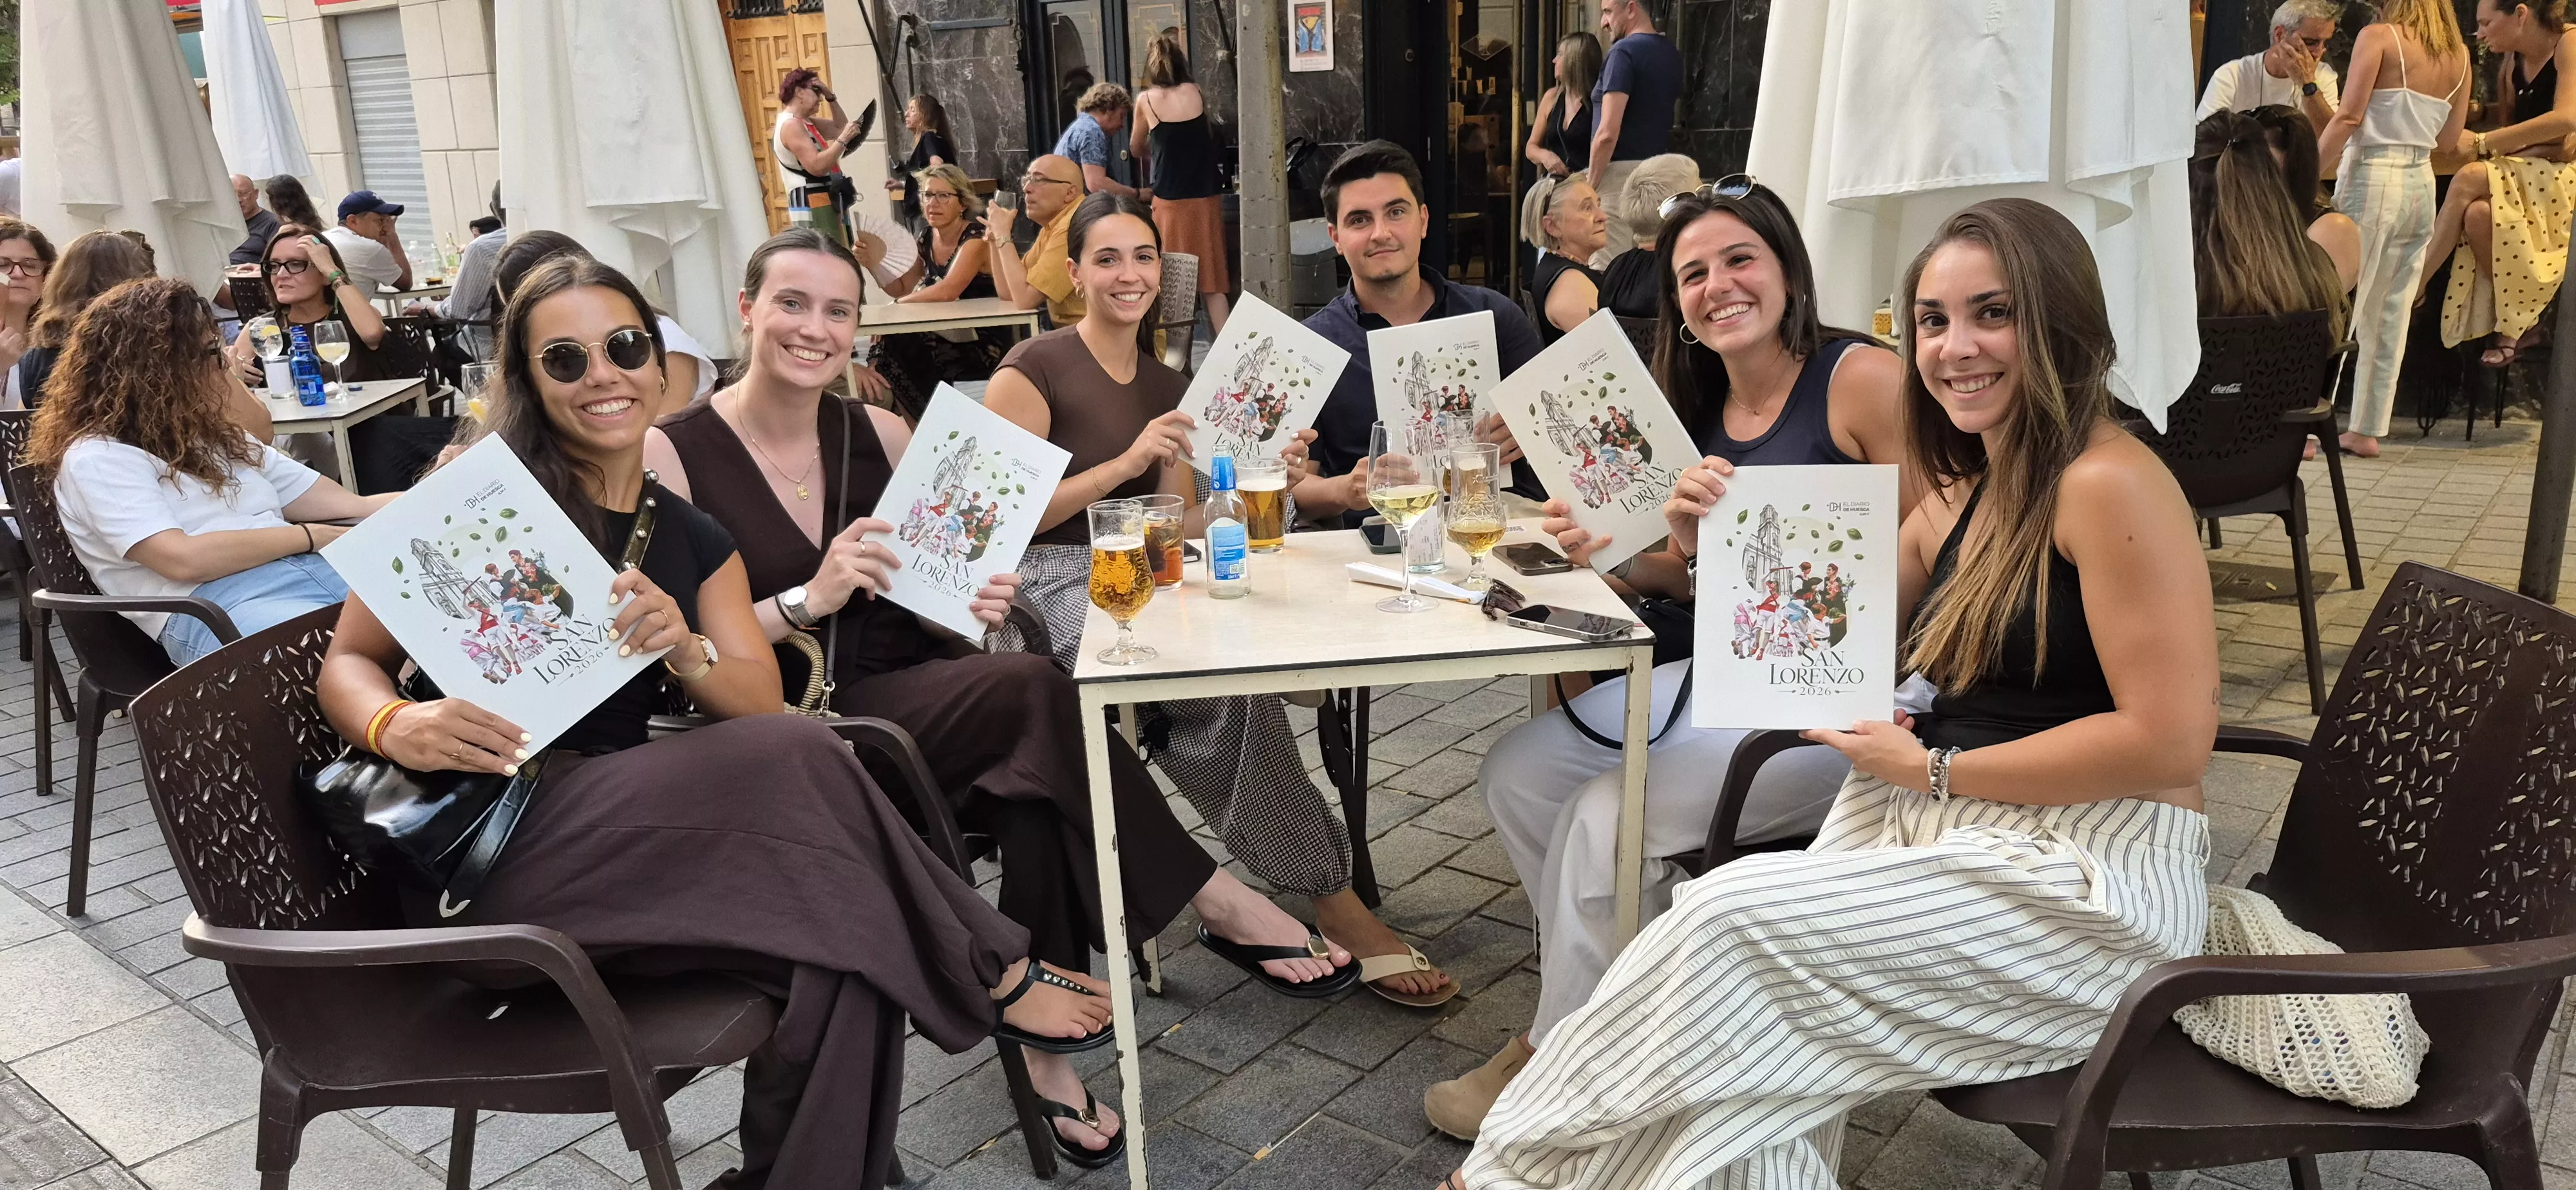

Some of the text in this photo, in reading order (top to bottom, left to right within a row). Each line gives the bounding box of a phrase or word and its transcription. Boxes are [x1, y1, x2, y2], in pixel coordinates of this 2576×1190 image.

[2211, 382, 2242, 394] Coca-Cola
[482, 479, 500, 493] DIARIO
[1633, 462, 1665, 489] SAN
[487, 484, 504, 497] HUESCA
[912, 554, 980, 597] LORENZO
[940, 554, 974, 579] SAN
[928, 581, 951, 596] 2026
[550, 614, 593, 650] SAN
[574, 651, 603, 674] 2026
[1801, 647, 1844, 667] SAN
[1769, 663, 1864, 687] LORENZO
[1799, 687, 1832, 695] 2026
